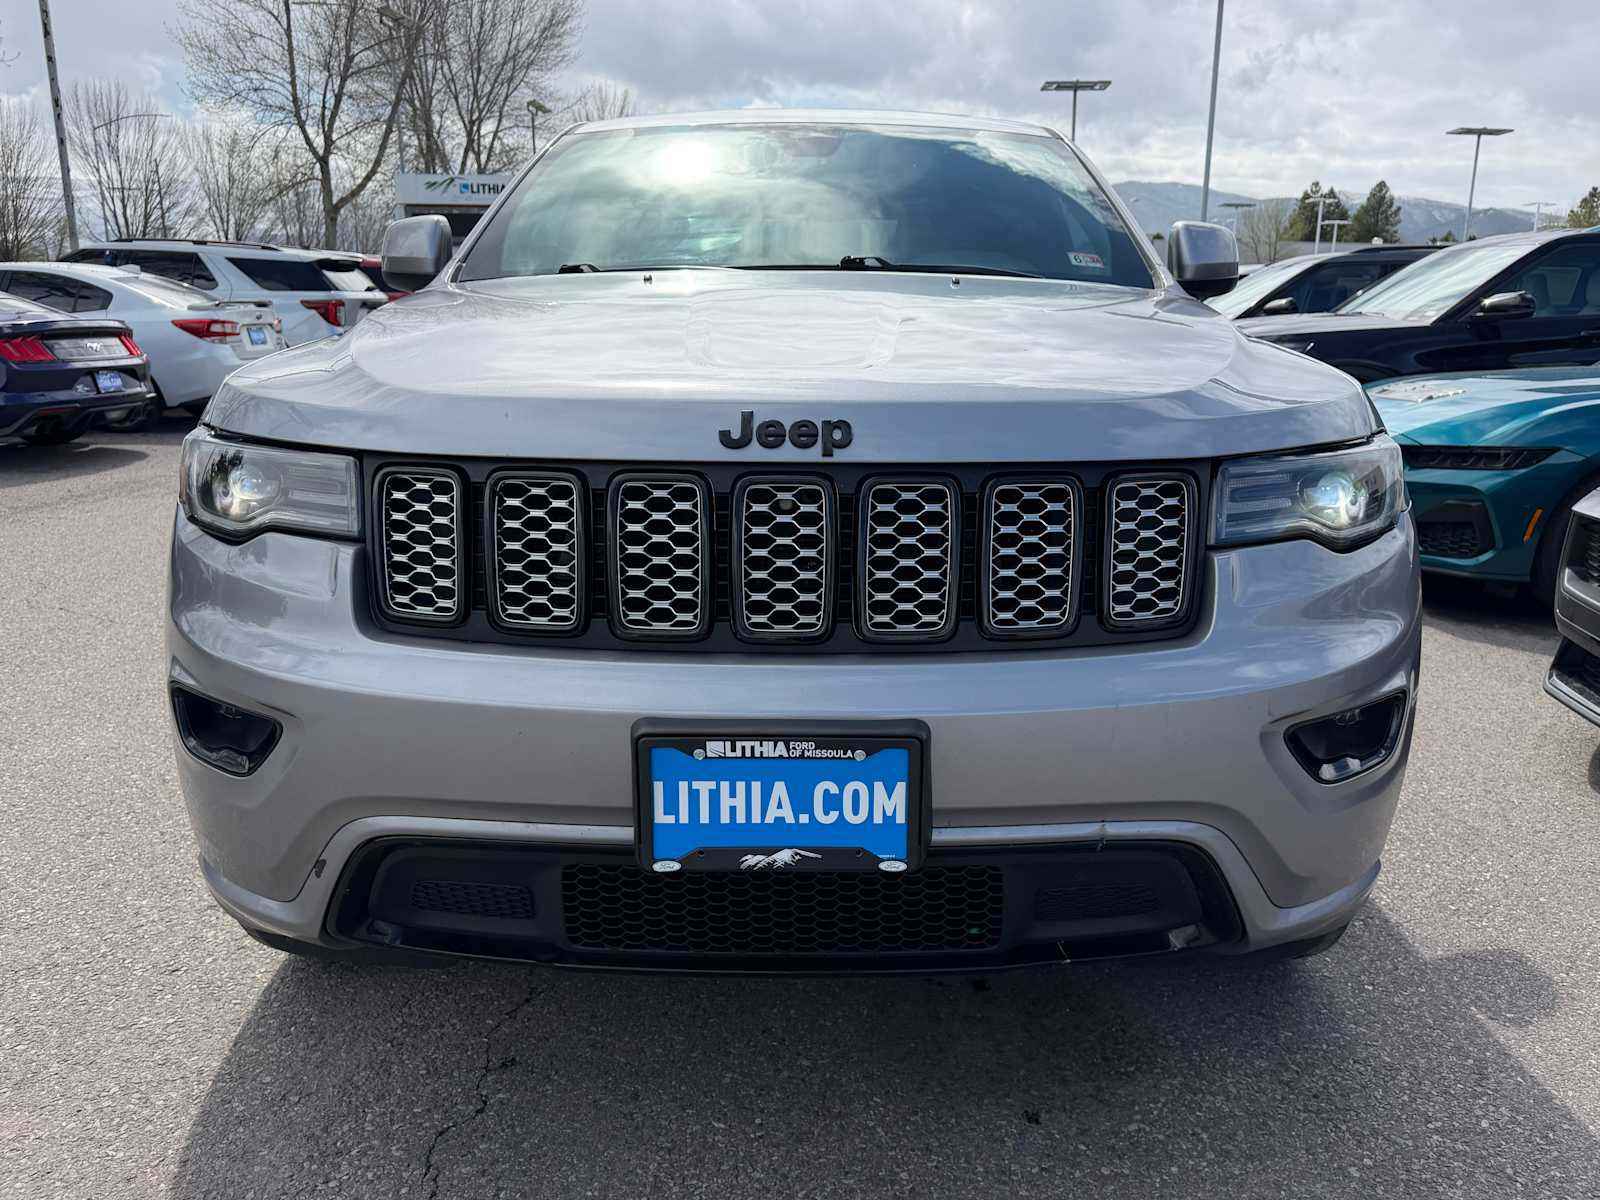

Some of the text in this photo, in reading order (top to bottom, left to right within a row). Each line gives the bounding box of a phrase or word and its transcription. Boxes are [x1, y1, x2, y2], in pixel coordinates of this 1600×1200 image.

[718, 409, 853, 457] Jeep
[724, 741, 815, 758] LITHIA FORD
[790, 750, 853, 758] OF MISSOULA
[653, 780, 907, 825] LITHIA.COM
